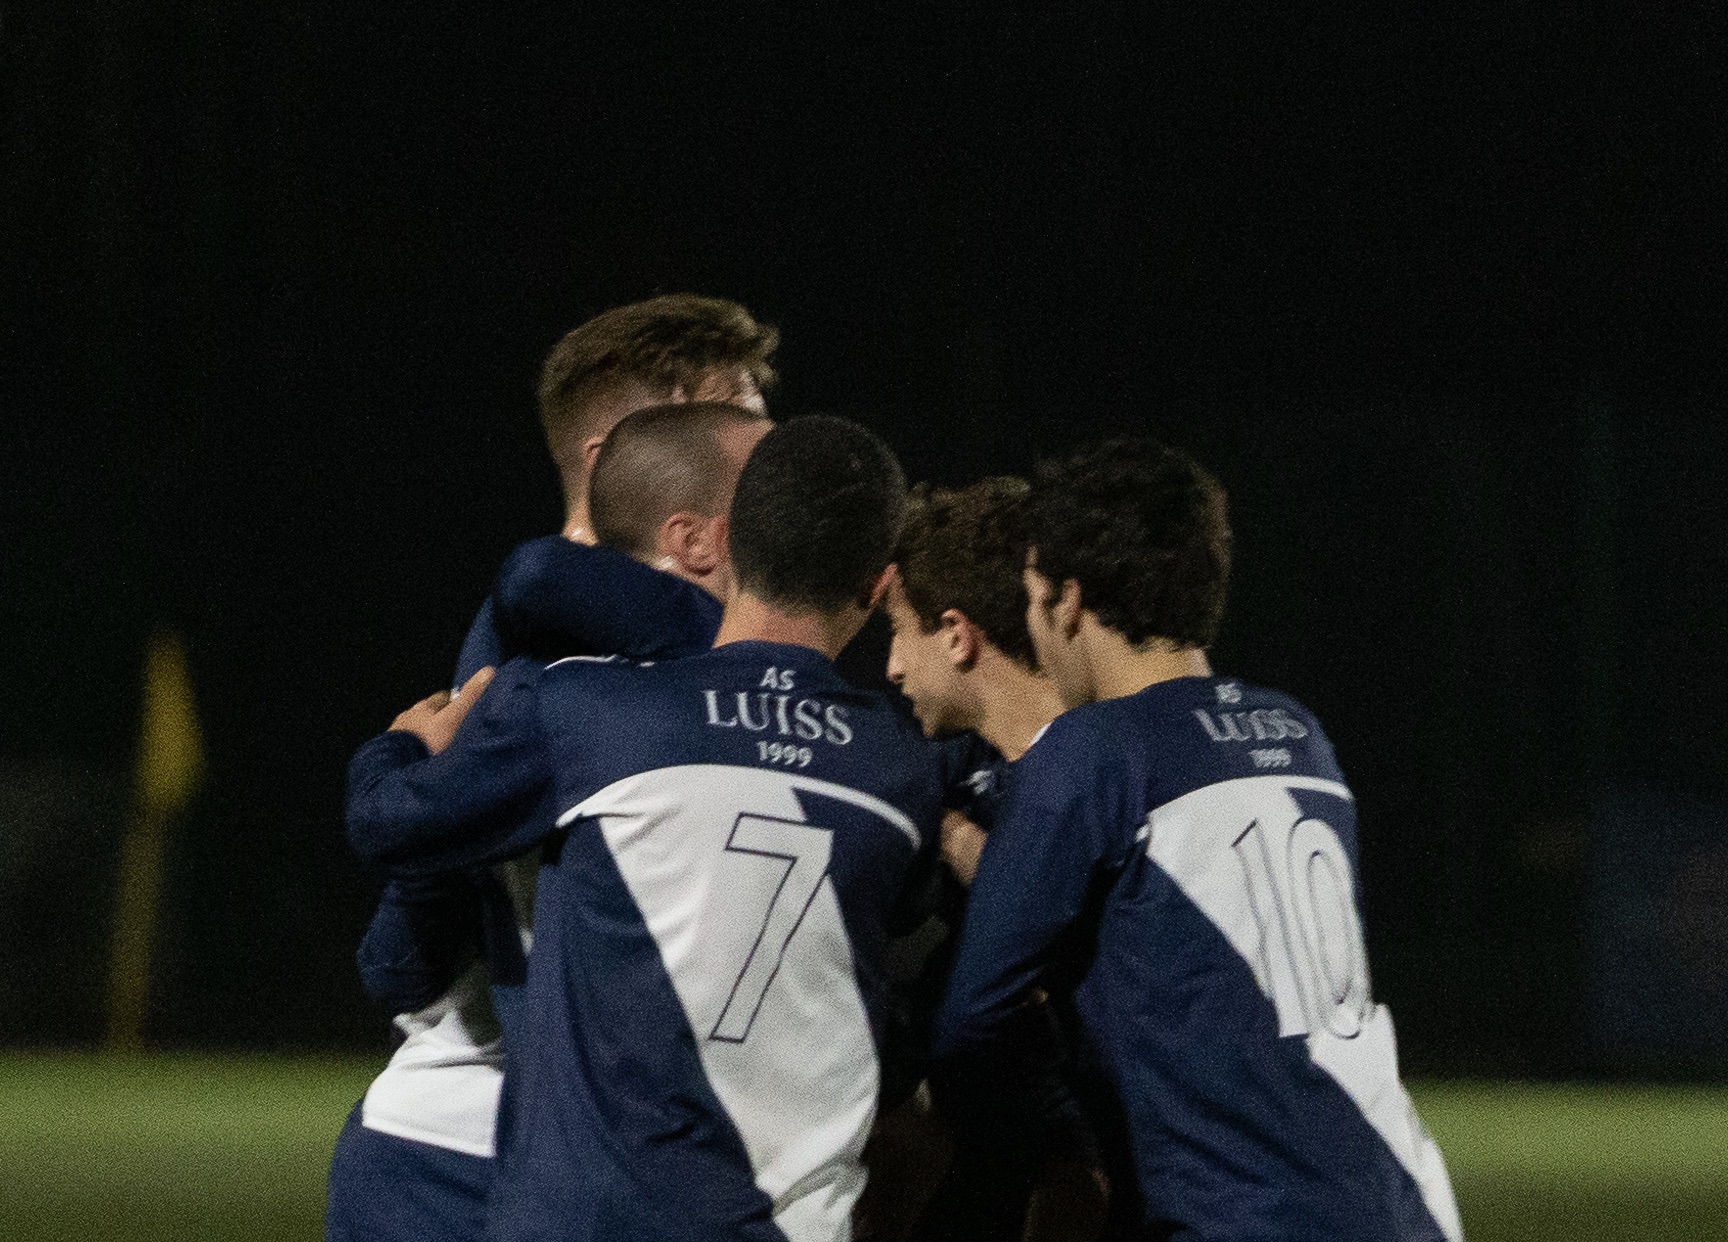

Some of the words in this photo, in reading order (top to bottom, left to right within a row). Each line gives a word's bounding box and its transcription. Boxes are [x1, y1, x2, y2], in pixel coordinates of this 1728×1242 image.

[759, 666, 796, 691] AS
[702, 690, 853, 745] LUISS
[757, 740, 813, 767] 1999
[708, 811, 835, 1044] 7
[1231, 816, 1374, 1040] 10
